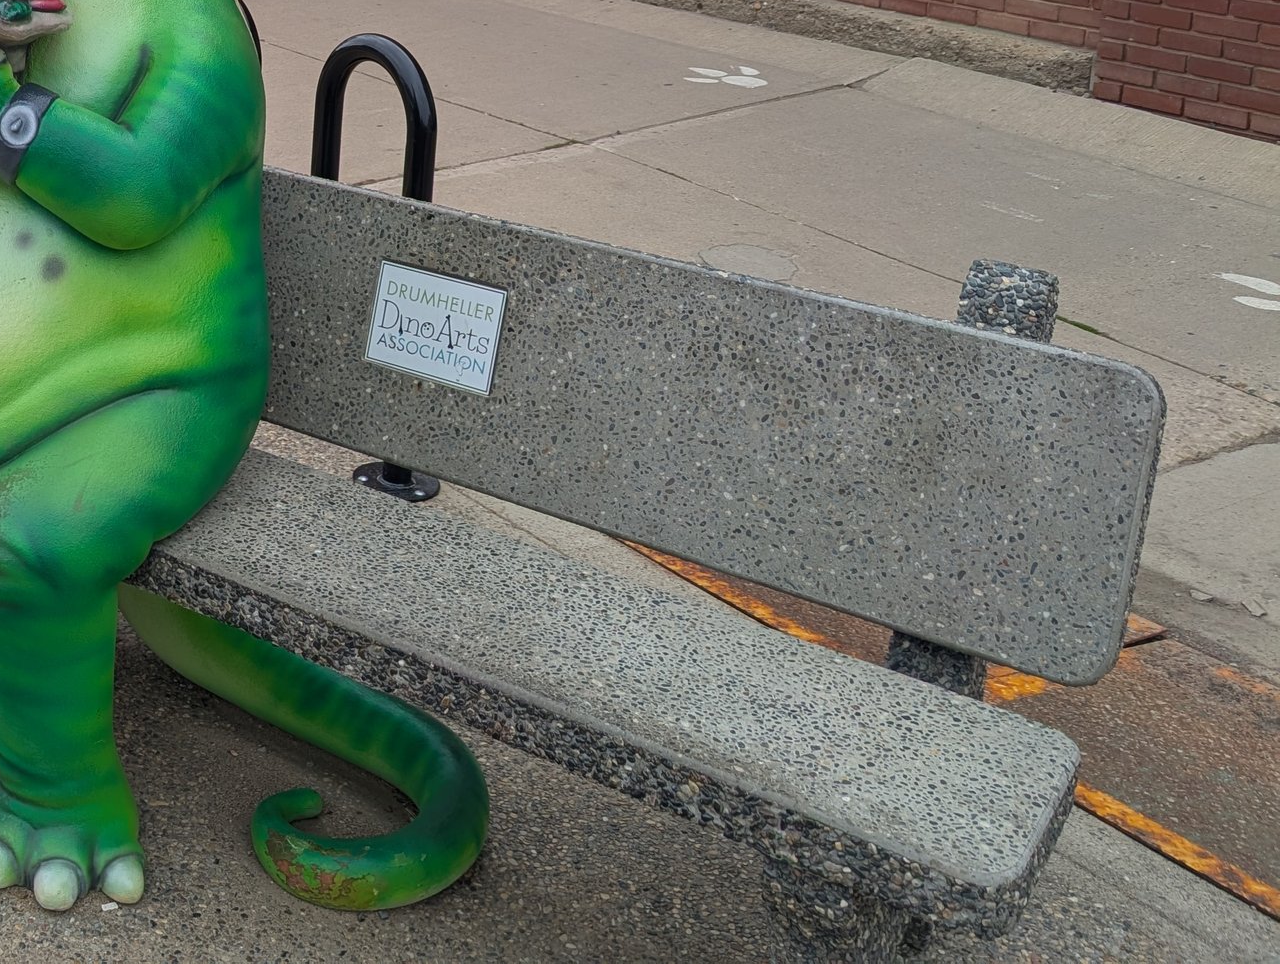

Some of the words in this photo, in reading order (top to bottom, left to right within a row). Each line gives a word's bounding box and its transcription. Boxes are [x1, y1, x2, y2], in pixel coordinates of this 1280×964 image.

[386, 280, 494, 322] DRUMHELLER
[378, 298, 490, 355] DinoArts
[376, 333, 486, 374] ASSOCIATION
